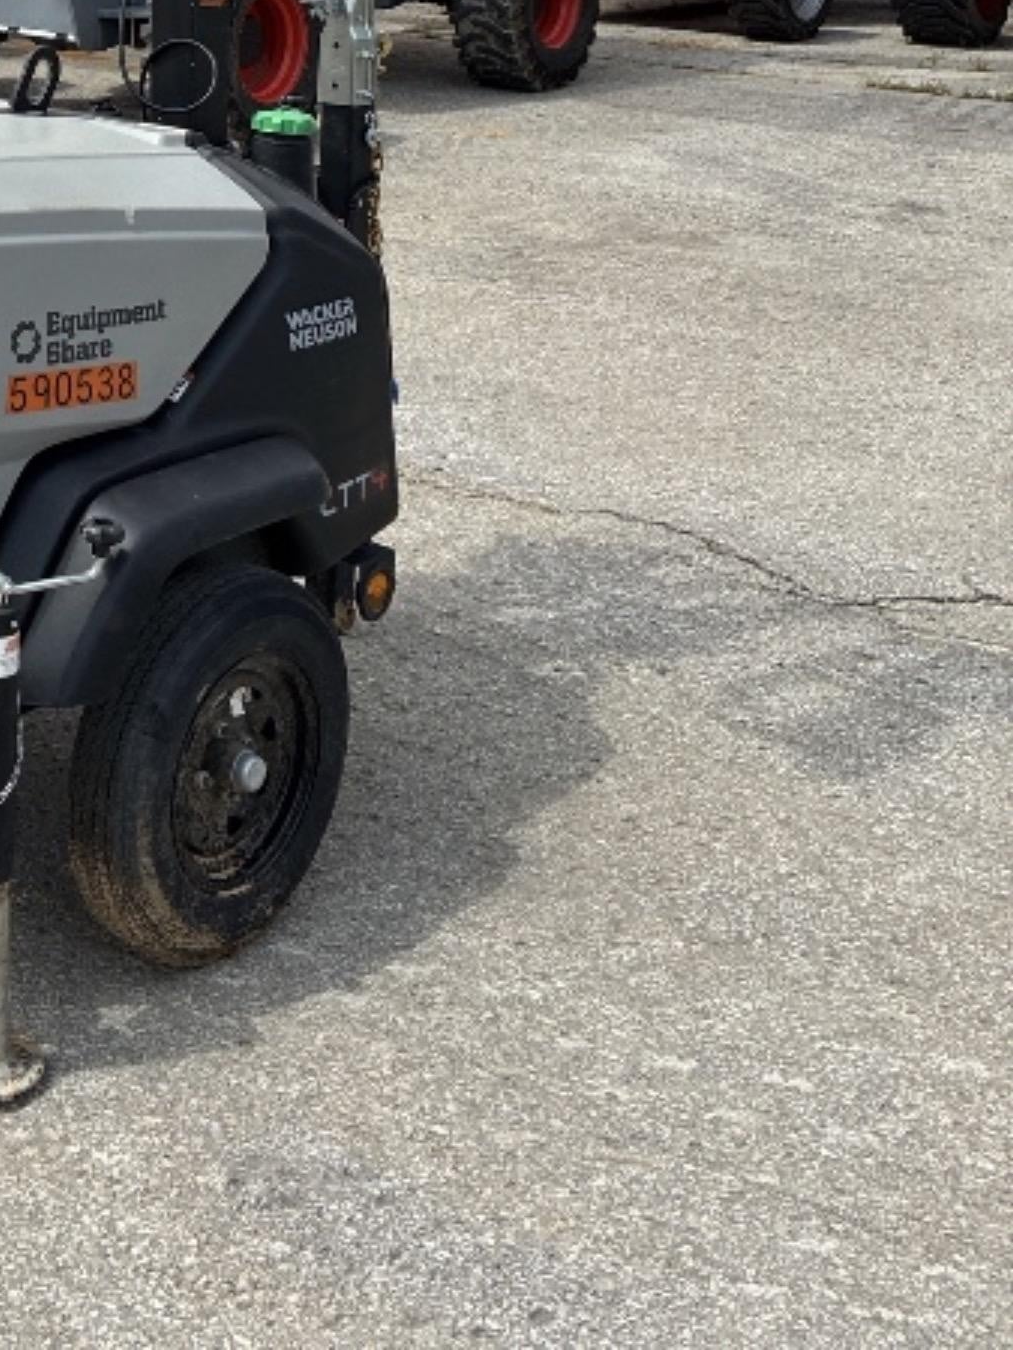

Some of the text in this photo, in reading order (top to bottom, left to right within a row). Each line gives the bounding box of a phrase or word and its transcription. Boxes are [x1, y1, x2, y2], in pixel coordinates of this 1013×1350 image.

[46, 299, 166, 338] Equipment
[285, 296, 354, 331] WACKER
[289, 312, 357, 352] NEUSON
[46, 337, 112, 366] Share
[9, 362, 136, 413] 590538
